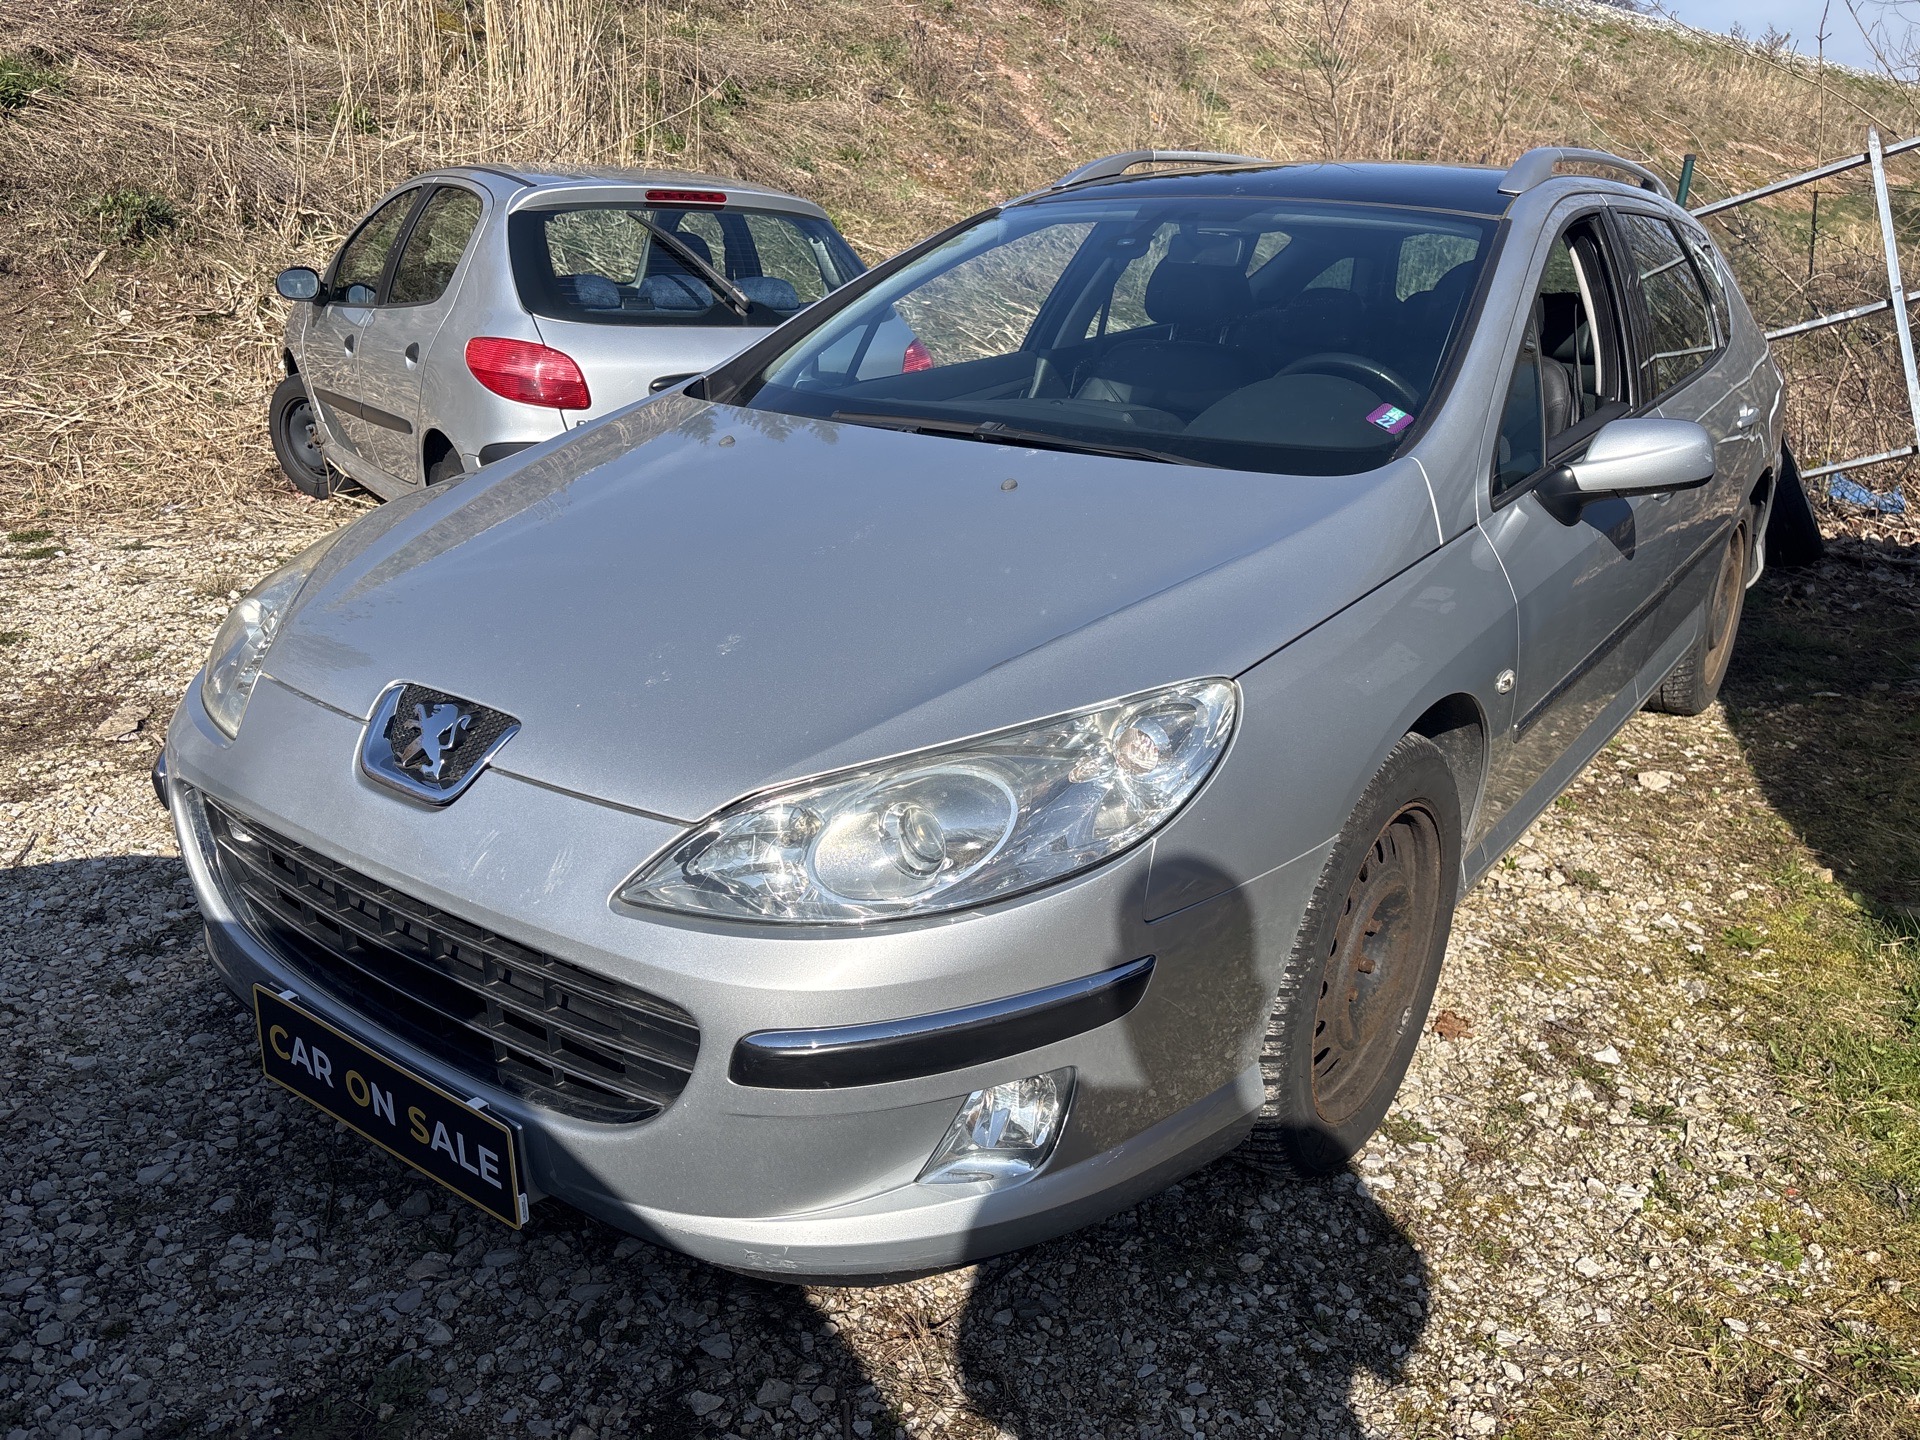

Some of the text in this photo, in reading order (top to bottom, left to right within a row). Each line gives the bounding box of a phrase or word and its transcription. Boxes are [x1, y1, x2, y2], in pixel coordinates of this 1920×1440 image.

[1375, 414, 1397, 429] 22
[269, 1024, 502, 1190] CAR ON SALE
